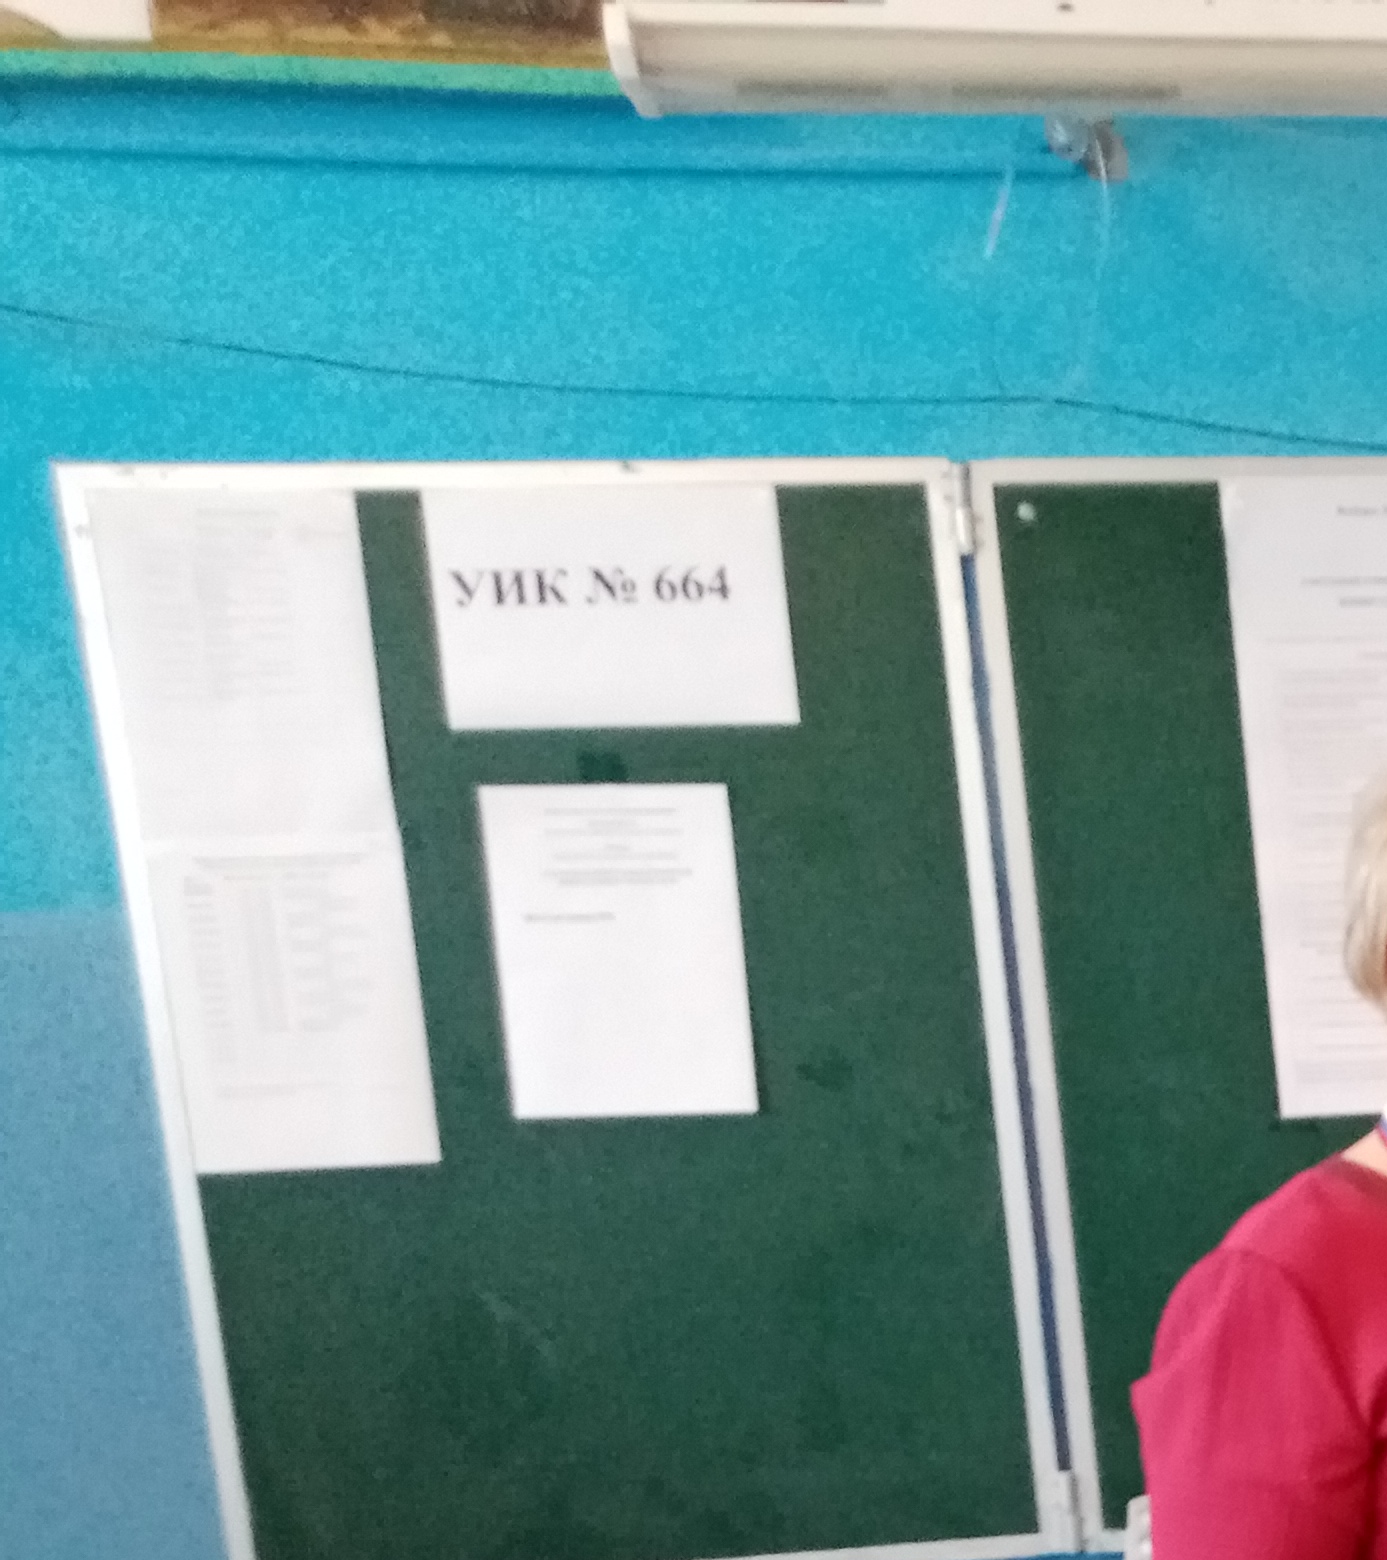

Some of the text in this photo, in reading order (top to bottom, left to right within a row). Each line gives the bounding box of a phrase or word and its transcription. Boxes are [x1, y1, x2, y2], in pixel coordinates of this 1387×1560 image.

[449, 563, 733, 608] УИК № 664
